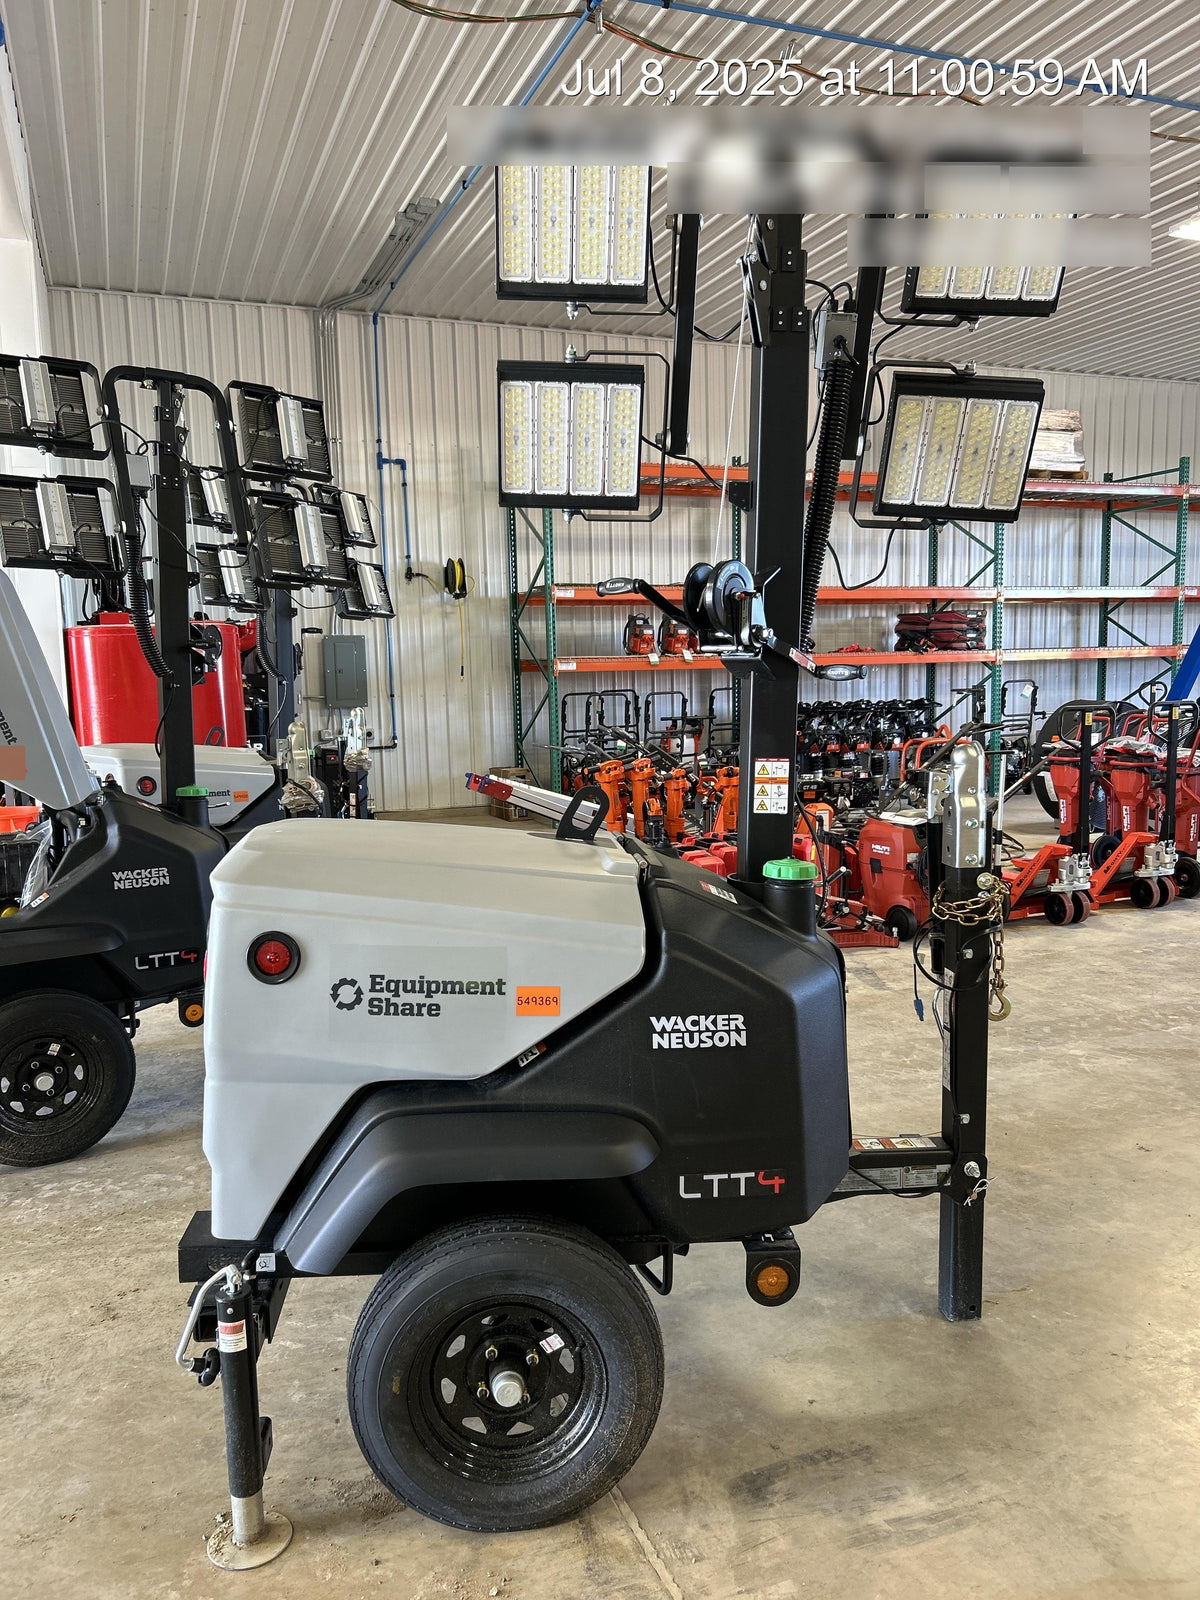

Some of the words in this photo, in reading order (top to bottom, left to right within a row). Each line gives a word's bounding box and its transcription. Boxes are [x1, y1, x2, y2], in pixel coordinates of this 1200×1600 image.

[112, 867, 170, 881] WACKER
[113, 876, 170, 890] NEUSON
[134, 950, 198, 970] LTT4
[368, 974, 506, 998] Equipment
[367, 997, 441, 1017] Share
[517, 995, 559, 1006] 549369
[650, 1014, 747, 1032] WACKER
[652, 1030, 747, 1050] NEUSON
[679, 1170, 786, 1199] LTT4
